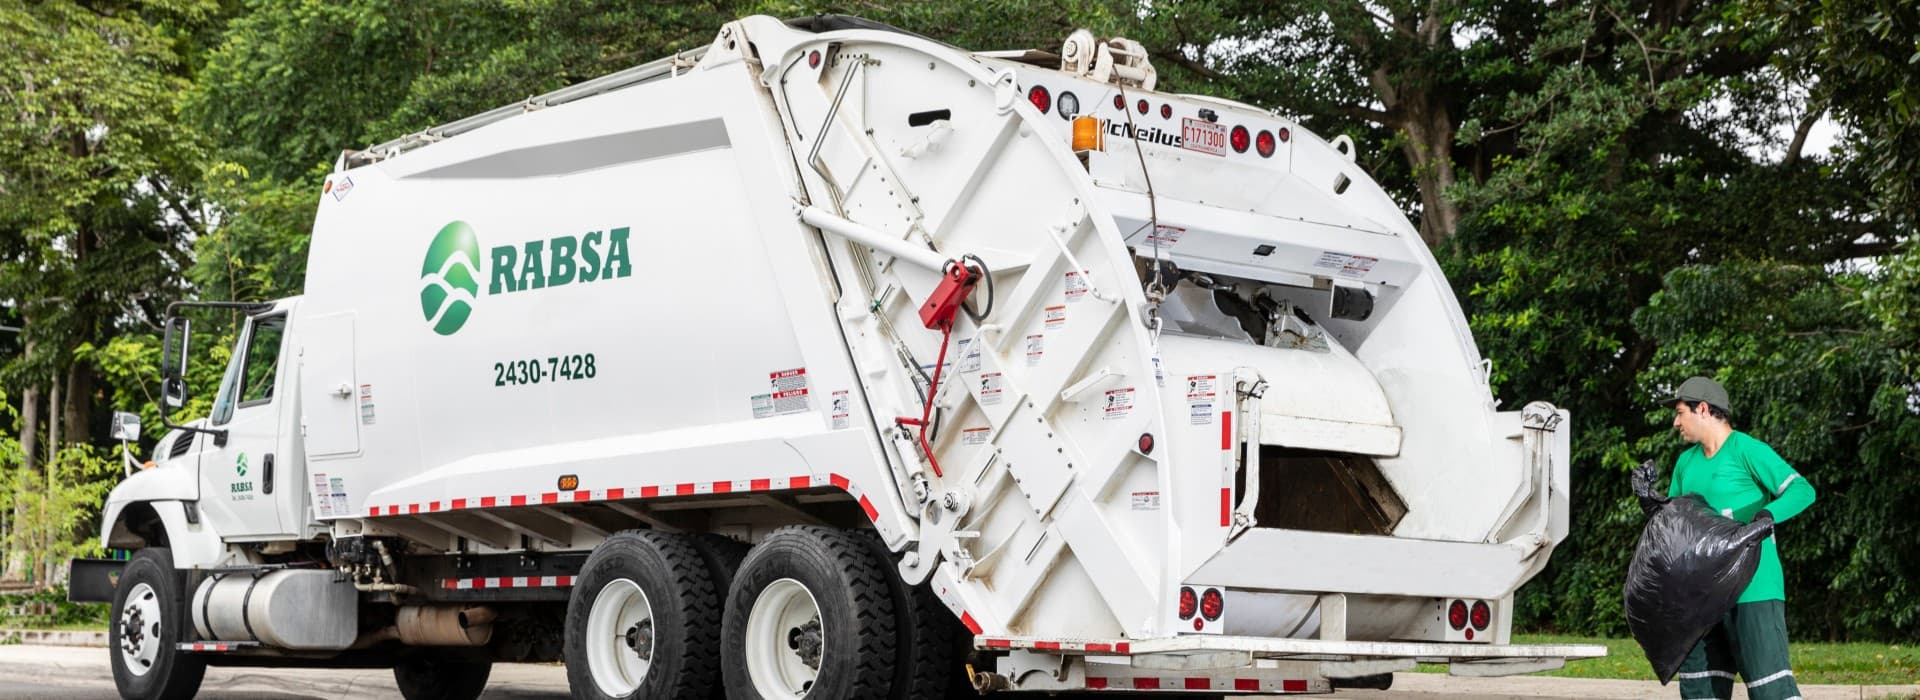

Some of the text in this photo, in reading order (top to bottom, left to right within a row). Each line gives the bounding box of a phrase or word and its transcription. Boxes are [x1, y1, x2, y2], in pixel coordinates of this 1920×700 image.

[1184, 126, 1225, 148] C171300
[488, 226, 632, 295] RABSA
[494, 353, 597, 387] 2430-7428
[231, 481, 253, 493] RABSA
